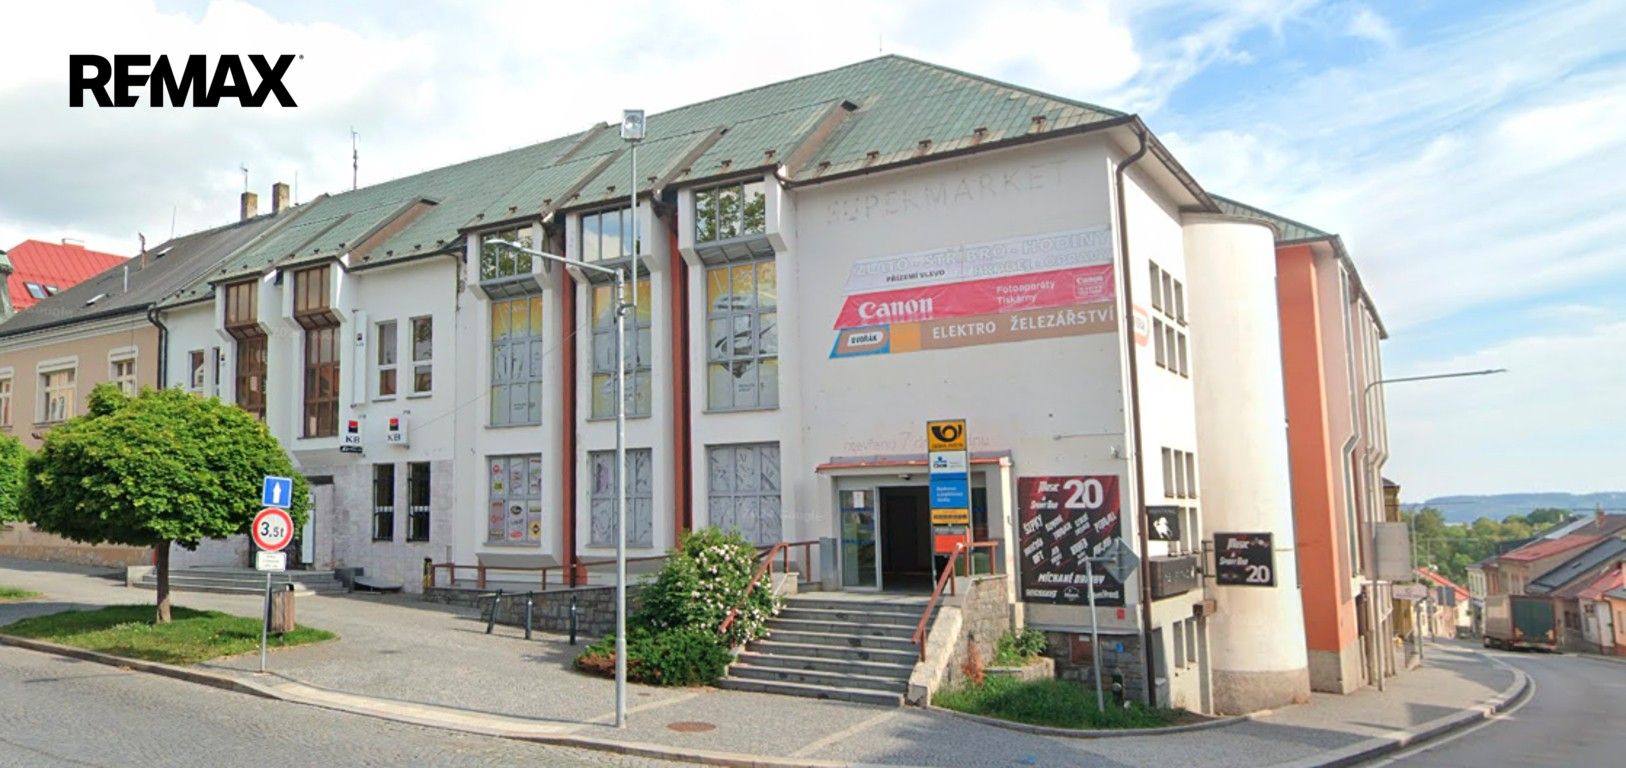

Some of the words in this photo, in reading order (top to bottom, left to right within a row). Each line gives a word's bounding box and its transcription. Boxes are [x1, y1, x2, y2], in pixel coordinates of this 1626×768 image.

[996, 280, 1056, 293] Fotoaparáty
[858, 297, 933, 319] Canon
[997, 294, 1037, 305] Tiskárny
[933, 321, 996, 339] ELEKTRO
[1010, 306, 1114, 331] ŽELEZÁŘSTVÍ
[346, 435, 360, 443] KB
[1063, 478, 1104, 509] 20
[1246, 565, 1270, 583] 20
